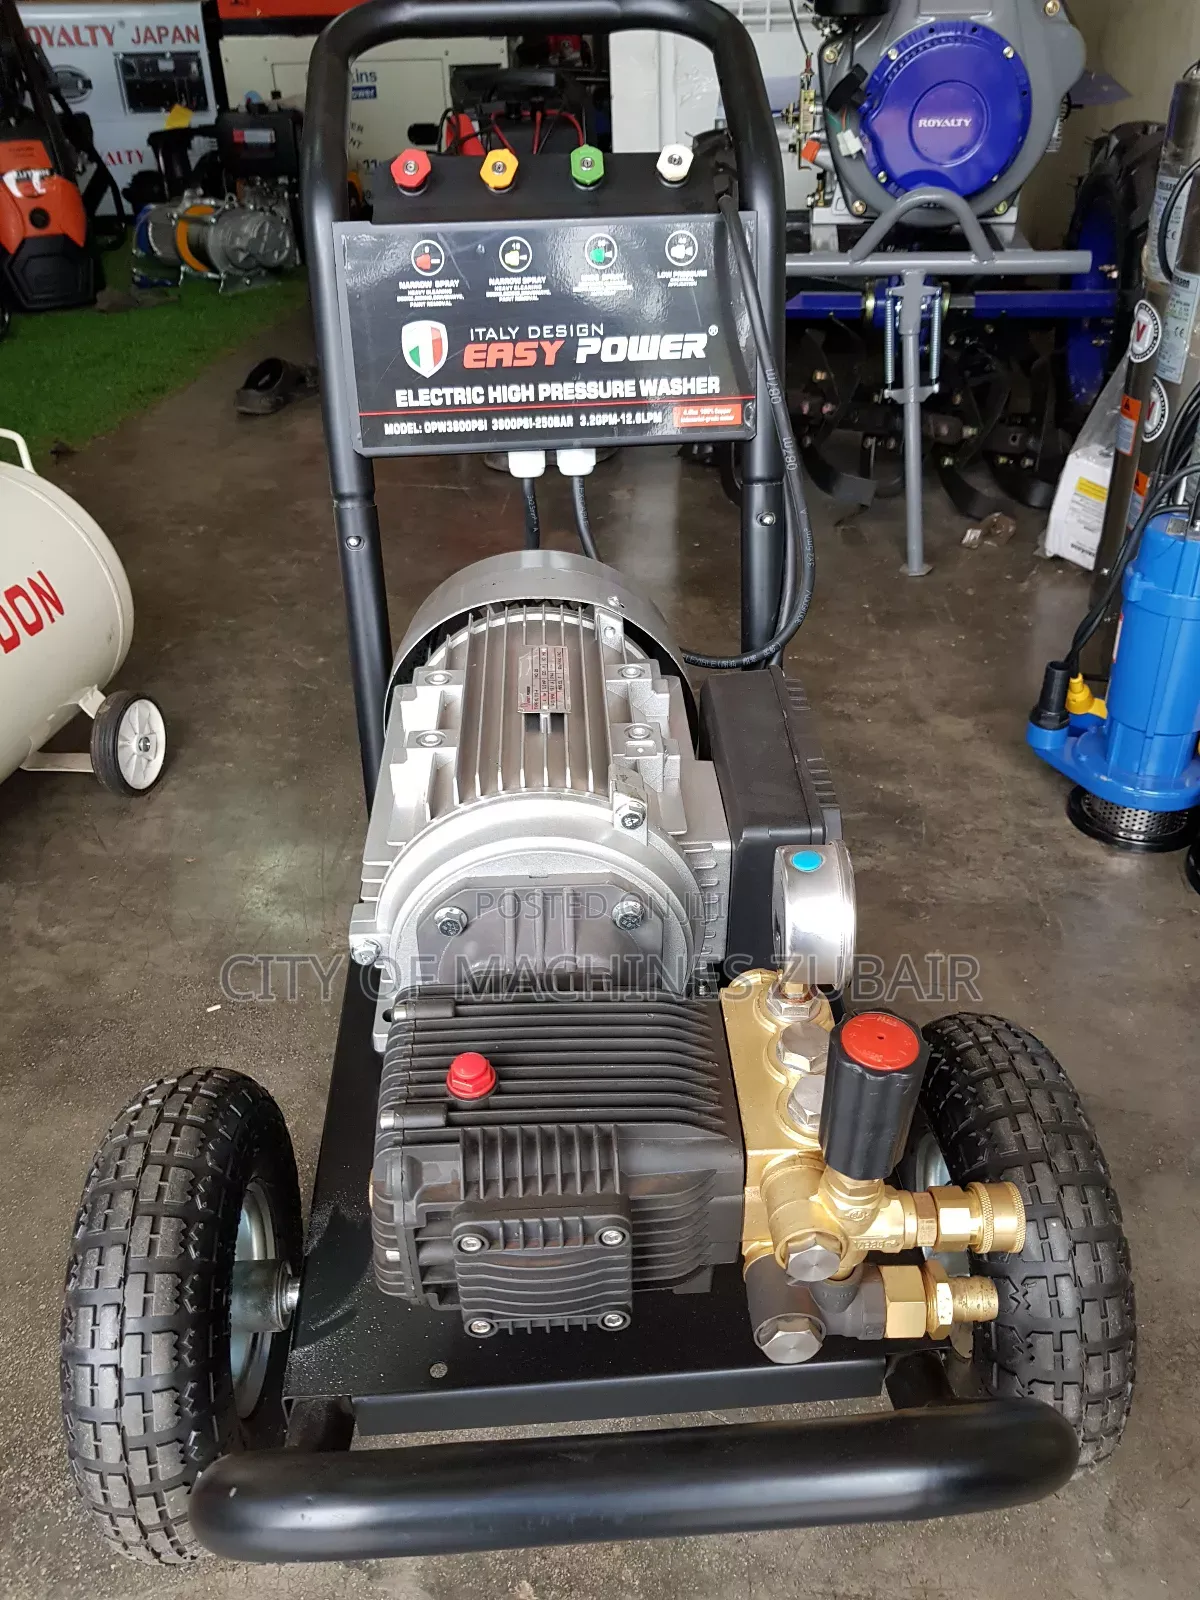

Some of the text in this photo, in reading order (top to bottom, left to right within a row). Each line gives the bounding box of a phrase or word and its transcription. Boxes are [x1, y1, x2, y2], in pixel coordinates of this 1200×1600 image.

[24, 25, 200, 47] OYALTY JAPAN
[918, 117, 972, 128] ROYALTY
[470, 323, 604, 341] ITALY DESIGN
[463, 333, 708, 369] EASY POWER
[395, 375, 720, 408] ELECTRIC HIGH PRESSURE WASHER
[384, 421, 423, 435] MODEL:
